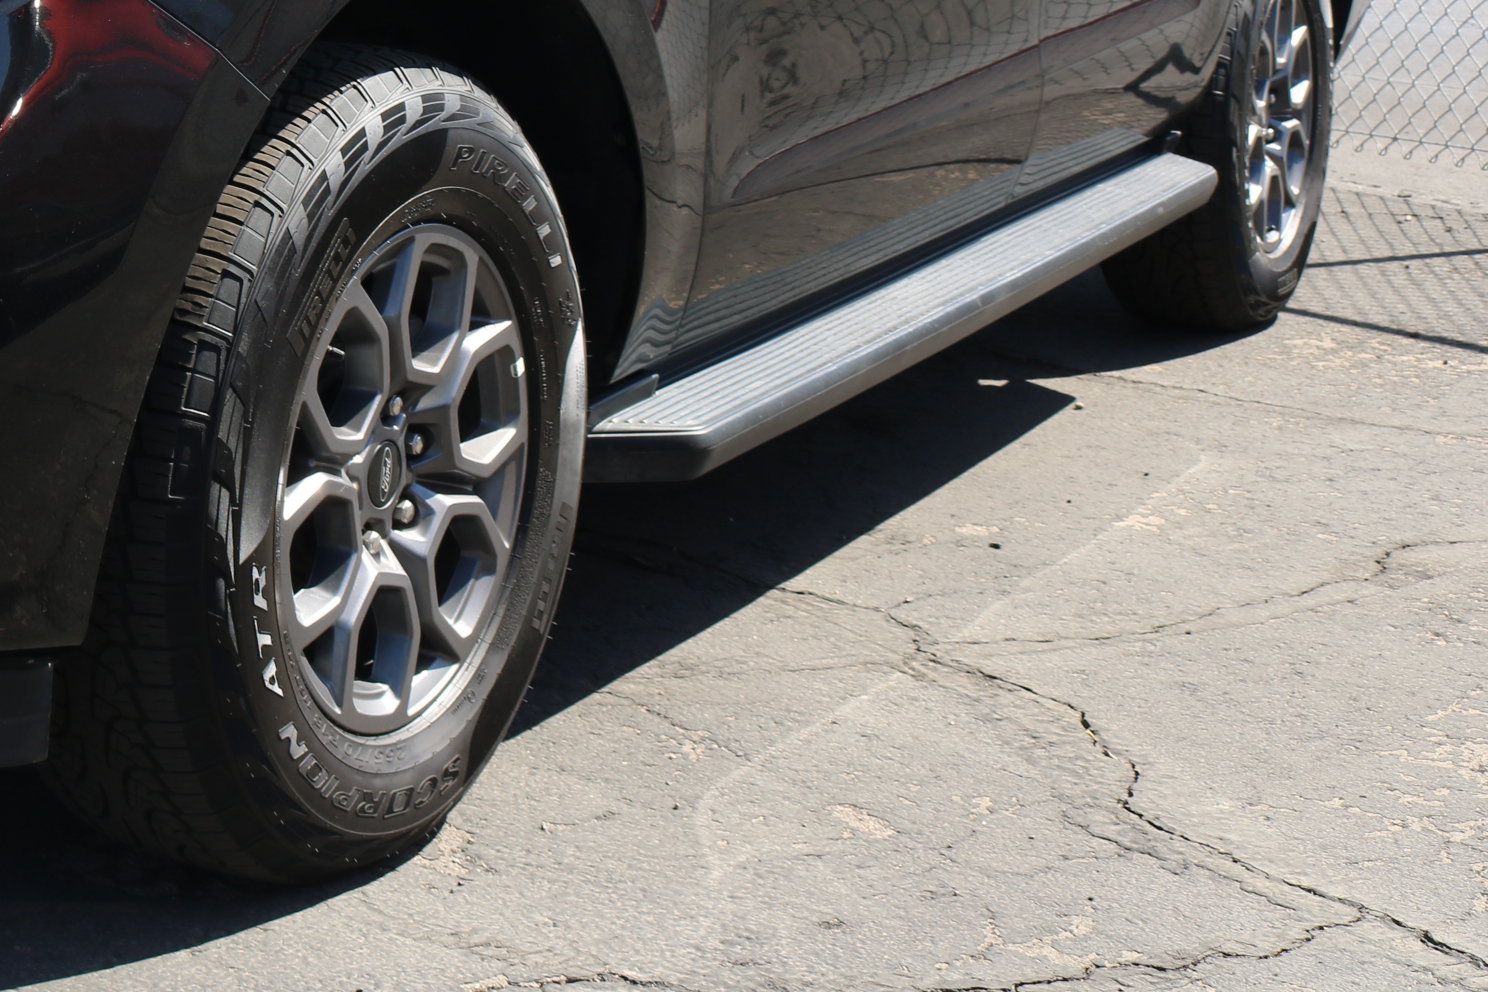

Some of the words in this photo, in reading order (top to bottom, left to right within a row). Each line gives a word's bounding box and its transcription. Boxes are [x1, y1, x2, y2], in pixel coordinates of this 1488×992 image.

[449, 144, 562, 268] PIRELLI
[286, 217, 357, 358] PIRELLI
[381, 456, 392, 492] Ford
[252, 562, 284, 698] ATR
[278, 721, 462, 820] SCORPION
